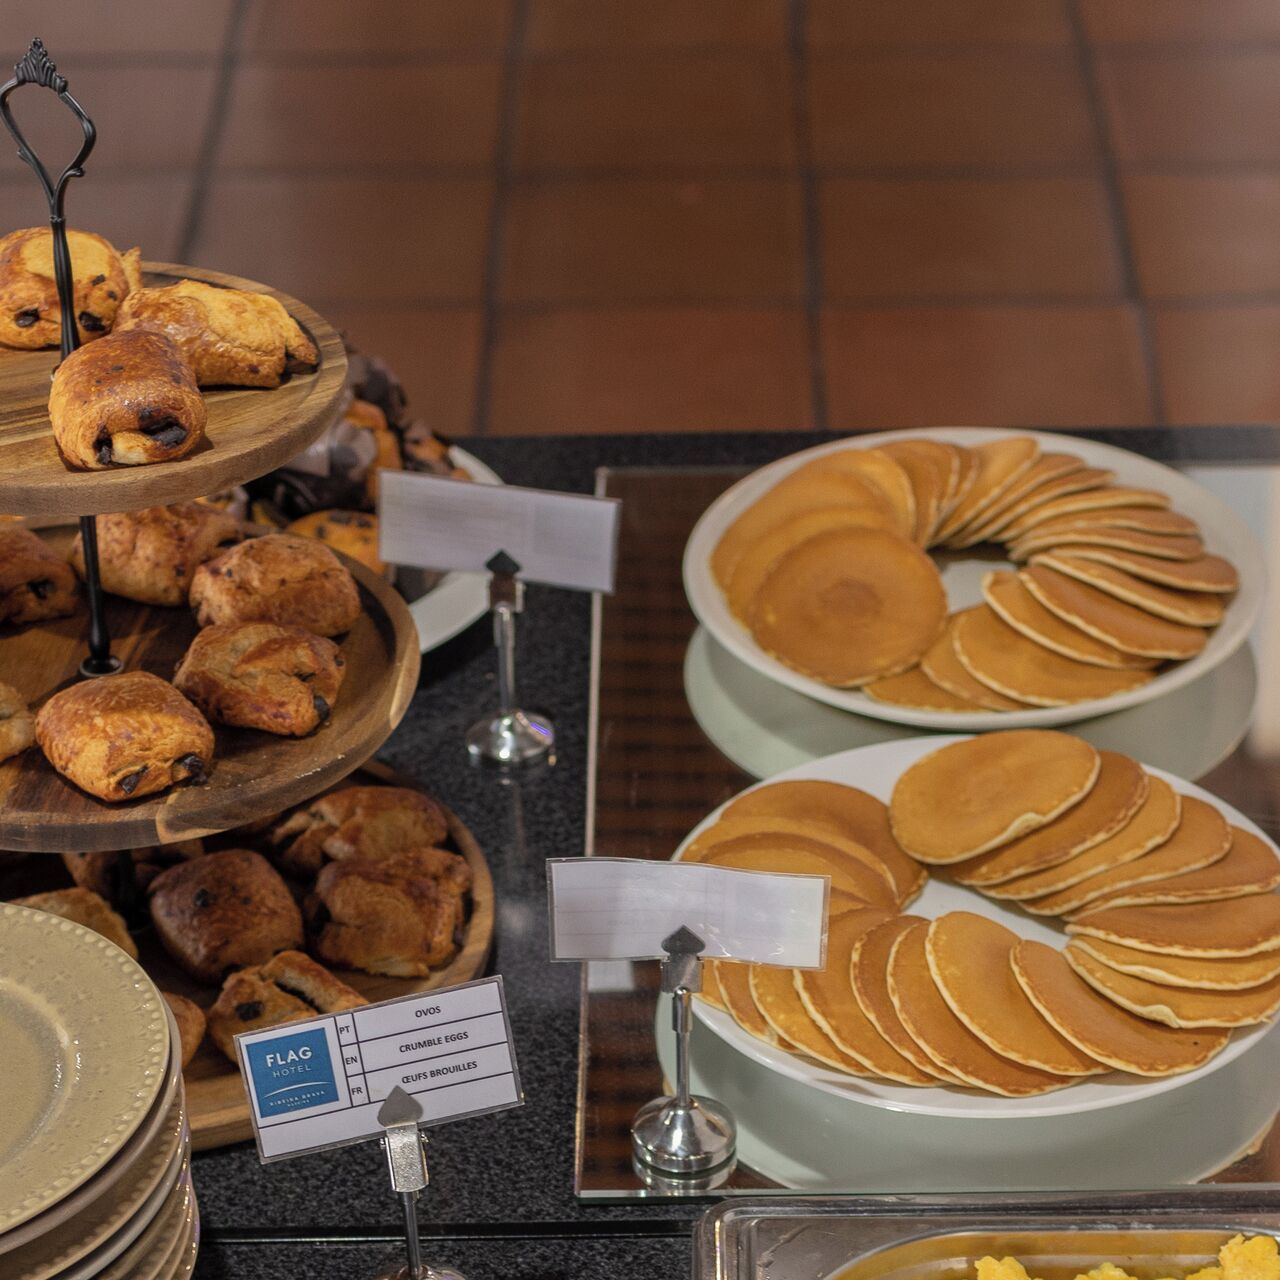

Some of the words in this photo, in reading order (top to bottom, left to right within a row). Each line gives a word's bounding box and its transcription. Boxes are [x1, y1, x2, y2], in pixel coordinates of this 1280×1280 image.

[415, 1006, 441, 1018] OVOS
[339, 1025, 351, 1035] PT
[399, 1036, 443, 1053] CRUMBLE
[444, 1031, 469, 1045] EGGS
[265, 1046, 313, 1068] FLAG
[345, 1055, 358, 1065] EN
[272, 1064, 312, 1079] HOTEL
[430, 1060, 478, 1079] BROUILLES
[351, 1086, 363, 1096] FR
